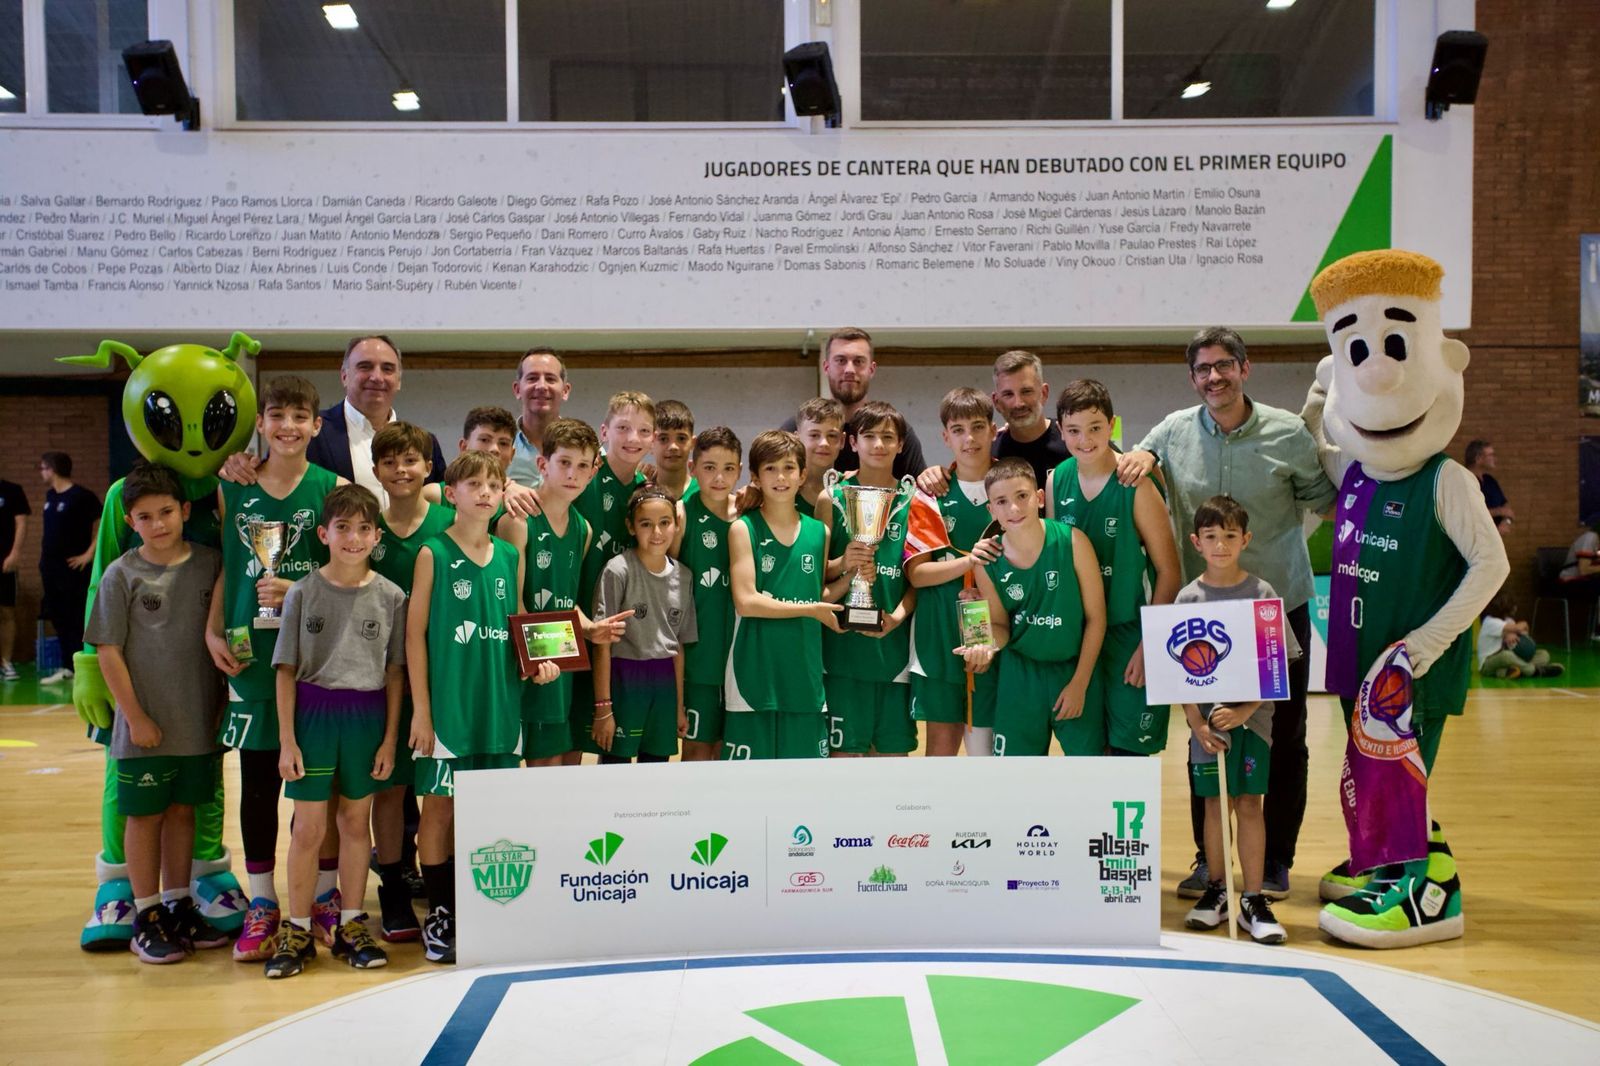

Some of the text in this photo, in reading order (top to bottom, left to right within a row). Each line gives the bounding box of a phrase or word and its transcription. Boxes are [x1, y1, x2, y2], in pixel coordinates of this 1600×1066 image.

[704, 152, 1347, 178] JUGADORES DE CANTERA QUE HAN DEBUTADO CON EL PRIMER EQUIPO
[53, 187, 1260, 210] Gallar Bernardo Paco Ramos Caneda Galeote Diego Rafa Pozo Aranda Pedro Armando Juan Antonio Emilio Osuna
[34, 204, 1232, 227] Pedro Miguel Lara Gaspar Antonio Villegas Fernando Jordi Grau Juan Rosa Miguel Manolo
[114, 221, 1250, 244] Pedro Bello Ricardo Antonio Mendoza Sergio Dani Romero Gaby Nacho Antonio Serrano Navarrete
[27, 237, 1197, 260] Gabriel Manu Carlos Cabezas Berni Francis Perujo Jon Fran Marcos Rafa Huertas Pablo Movilla Paulao Prestes
[34, 253, 1264, 277] de Cobos Pepe Pozas Alberto Abrines Luis Conde Dejan Kenan Ognjen Domas Sabonis Belemene Mo Viny Okouo Cristian Ignacio Rosa
[87, 279, 363, 291] Francis Alonso Nzosa Rafa Santos Mario
[1355, 530, 1398, 552] Unicaja
[876, 562, 901, 579] icaja
[1171, 617, 1227, 648] EBG
[223, 712, 253, 749] 57
[614, 810, 658, 819] Patrocinador
[1112, 801, 1146, 839] 17
[951, 839, 991, 849] KIA
[484, 851, 523, 862] ALL STAR
[1105, 858, 1137, 869] mini
[471, 864, 533, 891] MINI
[560, 869, 649, 889] Fundación
[670, 870, 749, 894] Unicaja
[1018, 880, 1050, 888] Proyecto
[1099, 860, 1152, 890] basket
[573, 886, 637, 904] Unicaja
[1104, 894, 1141, 903] abril 2024
